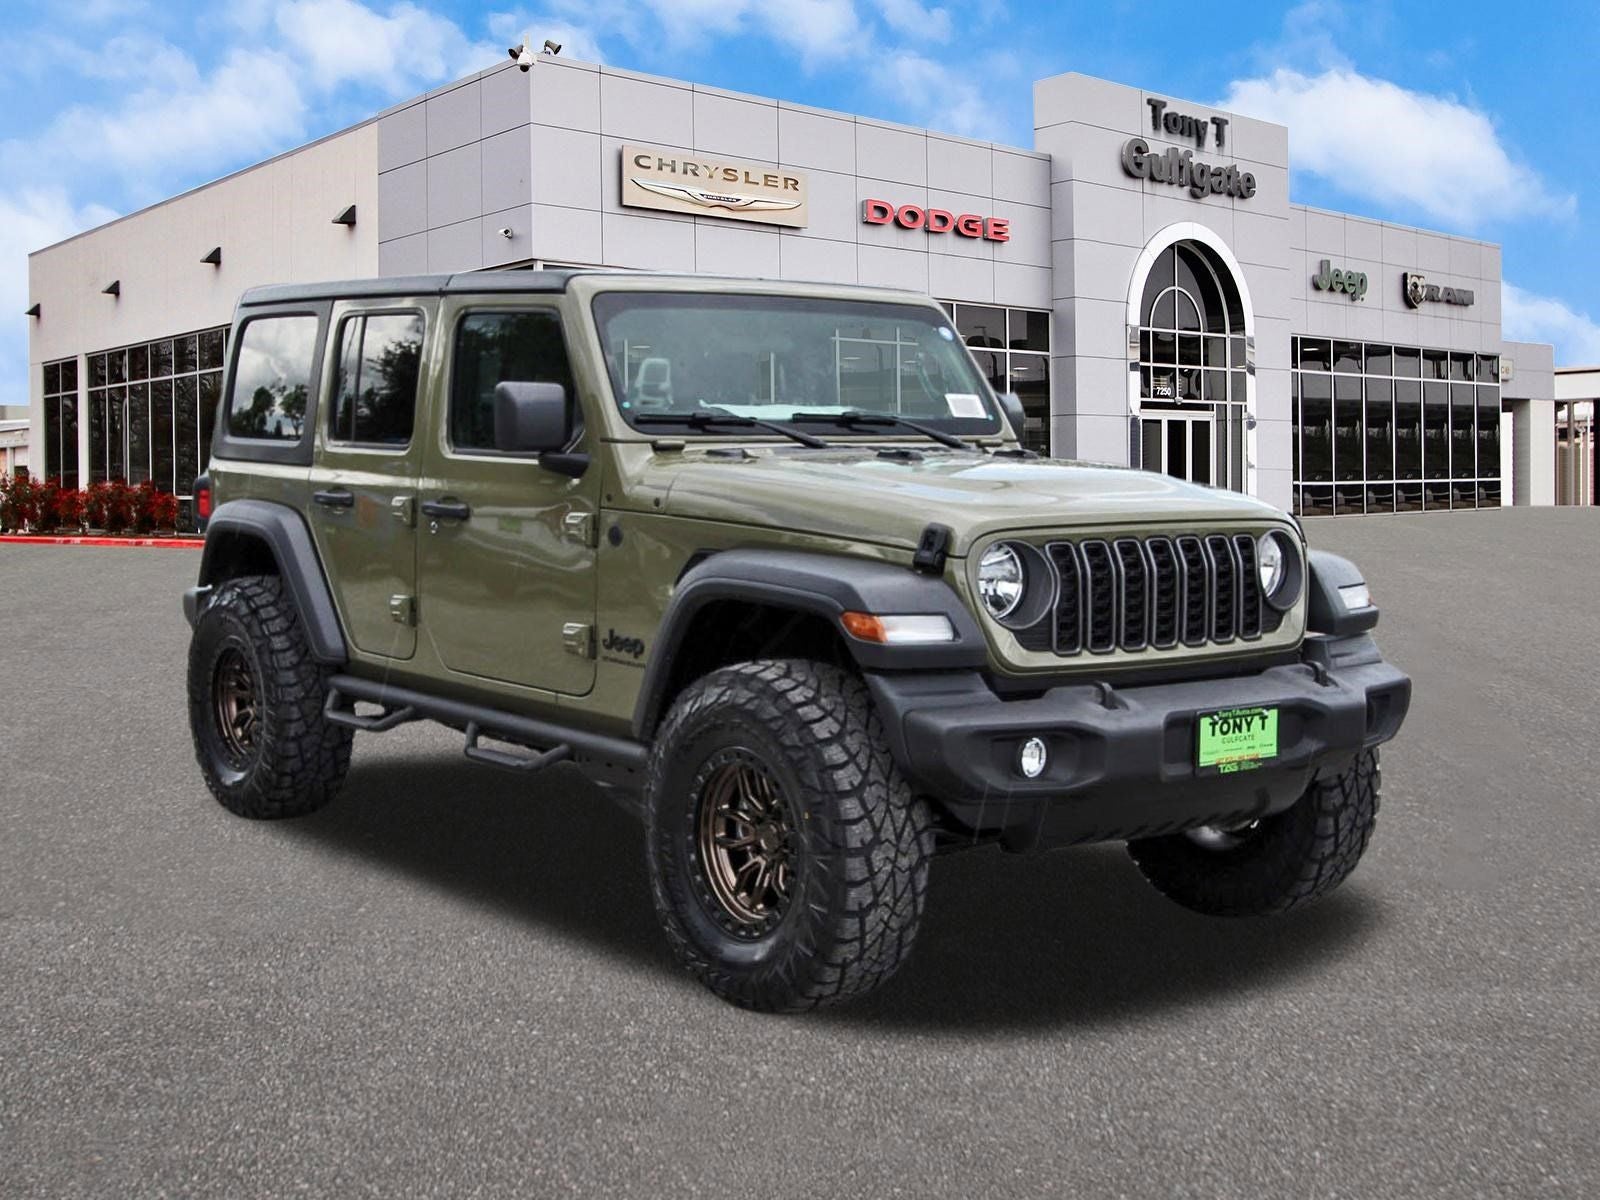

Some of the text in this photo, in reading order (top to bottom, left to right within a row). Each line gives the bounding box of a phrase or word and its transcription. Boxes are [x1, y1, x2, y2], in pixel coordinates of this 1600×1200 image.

[1147, 98, 1229, 147] Tony T
[633, 154, 800, 191] CHRYSLER
[1121, 138, 1256, 199] Gulfgate
[863, 199, 1010, 242] DODGE
[1312, 260, 1368, 302] Jeep
[1424, 284, 1474, 306] RAM
[1156, 387, 1171, 396] 7250
[602, 629, 645, 659] Jeep
[1209, 715, 1268, 737] TONY T
